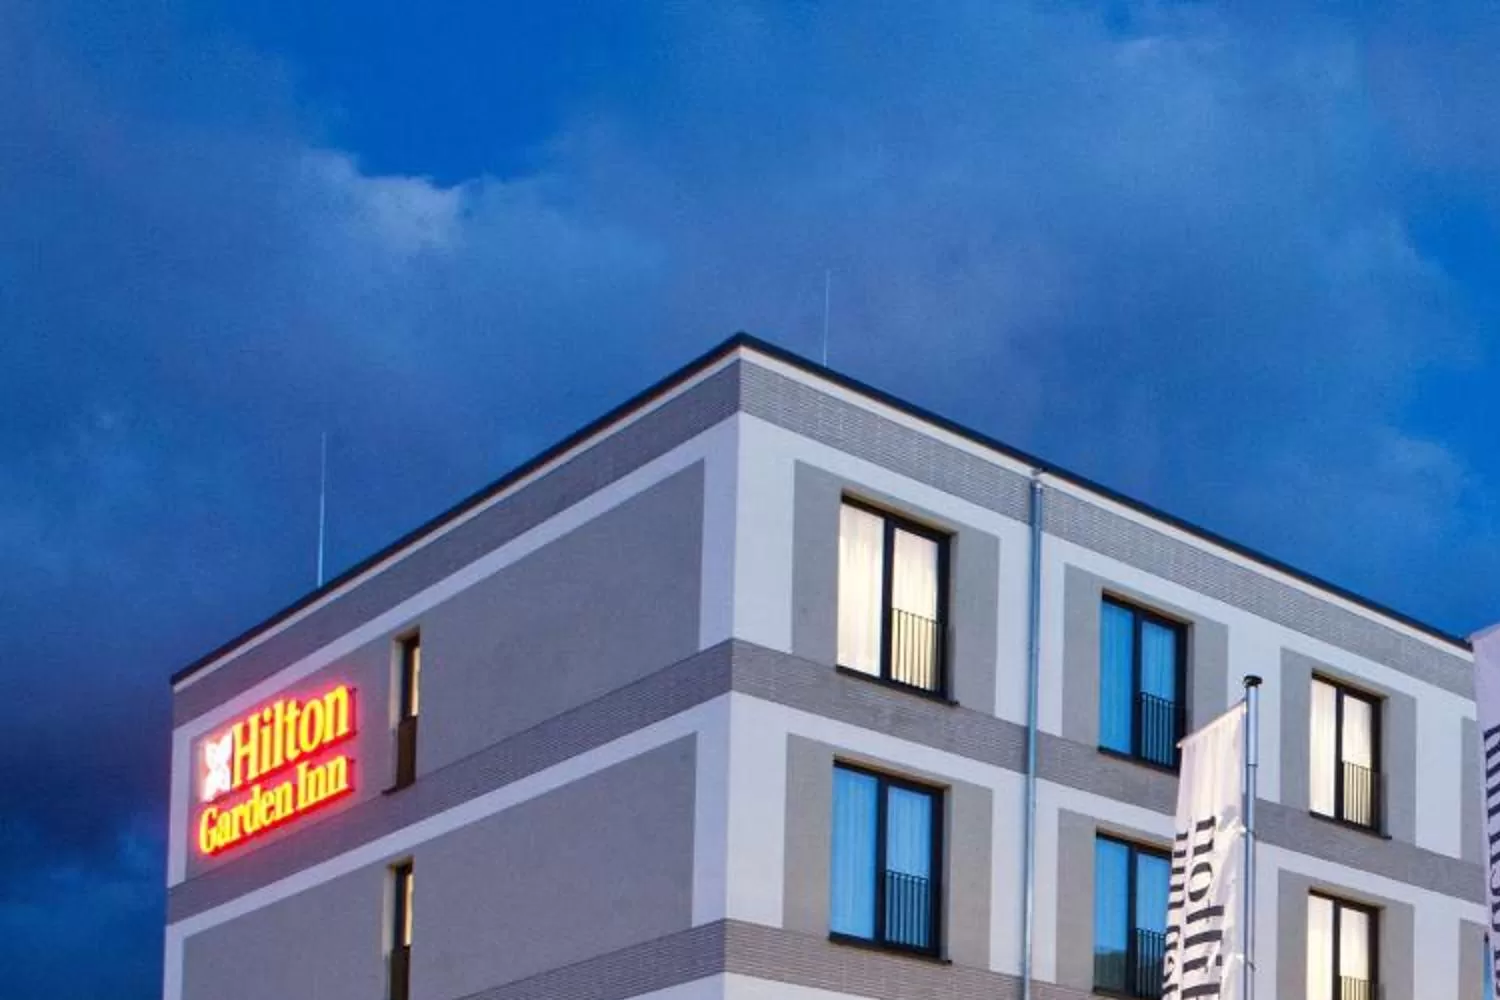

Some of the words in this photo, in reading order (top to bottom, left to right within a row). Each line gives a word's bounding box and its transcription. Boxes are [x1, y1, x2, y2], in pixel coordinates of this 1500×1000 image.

[231, 684, 350, 790] Hilton
[199, 780, 294, 854] Garden
[296, 755, 349, 810] Inn
